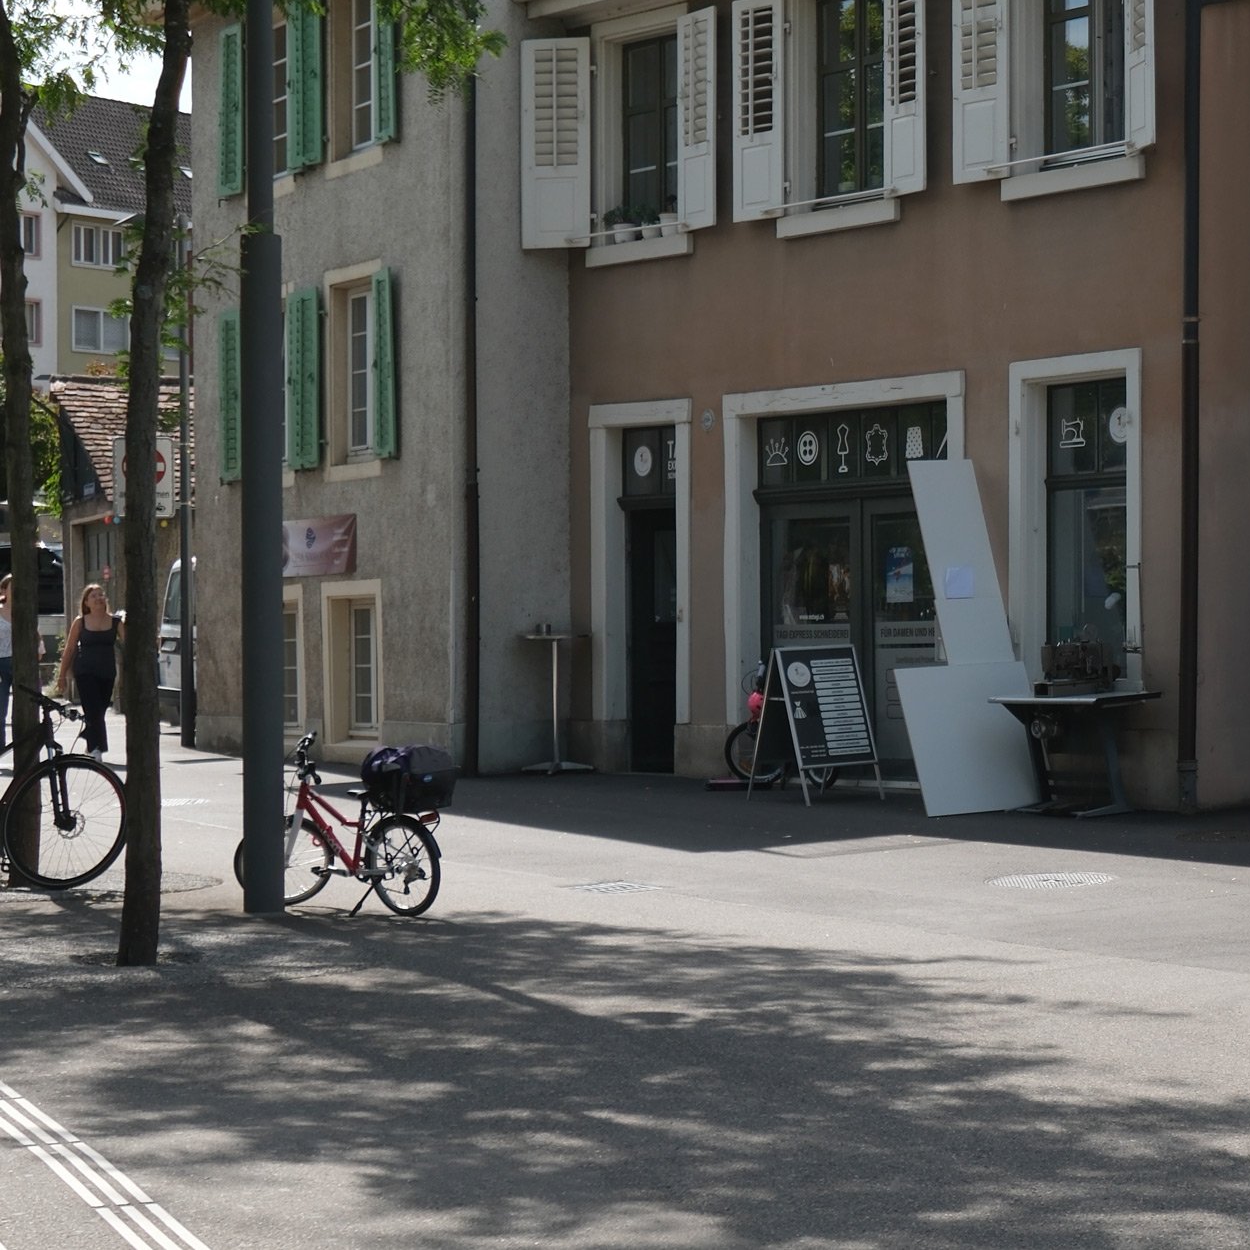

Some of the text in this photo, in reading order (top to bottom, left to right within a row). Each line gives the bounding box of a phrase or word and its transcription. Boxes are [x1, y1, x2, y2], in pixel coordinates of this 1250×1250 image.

[789, 629, 812, 639] EXPRESS
[813, 629, 849, 639] SCHNEIDEREI
[880, 626, 892, 638] FÜR
[893, 627, 914, 638] DAMEN
[914, 627, 927, 637] UND
